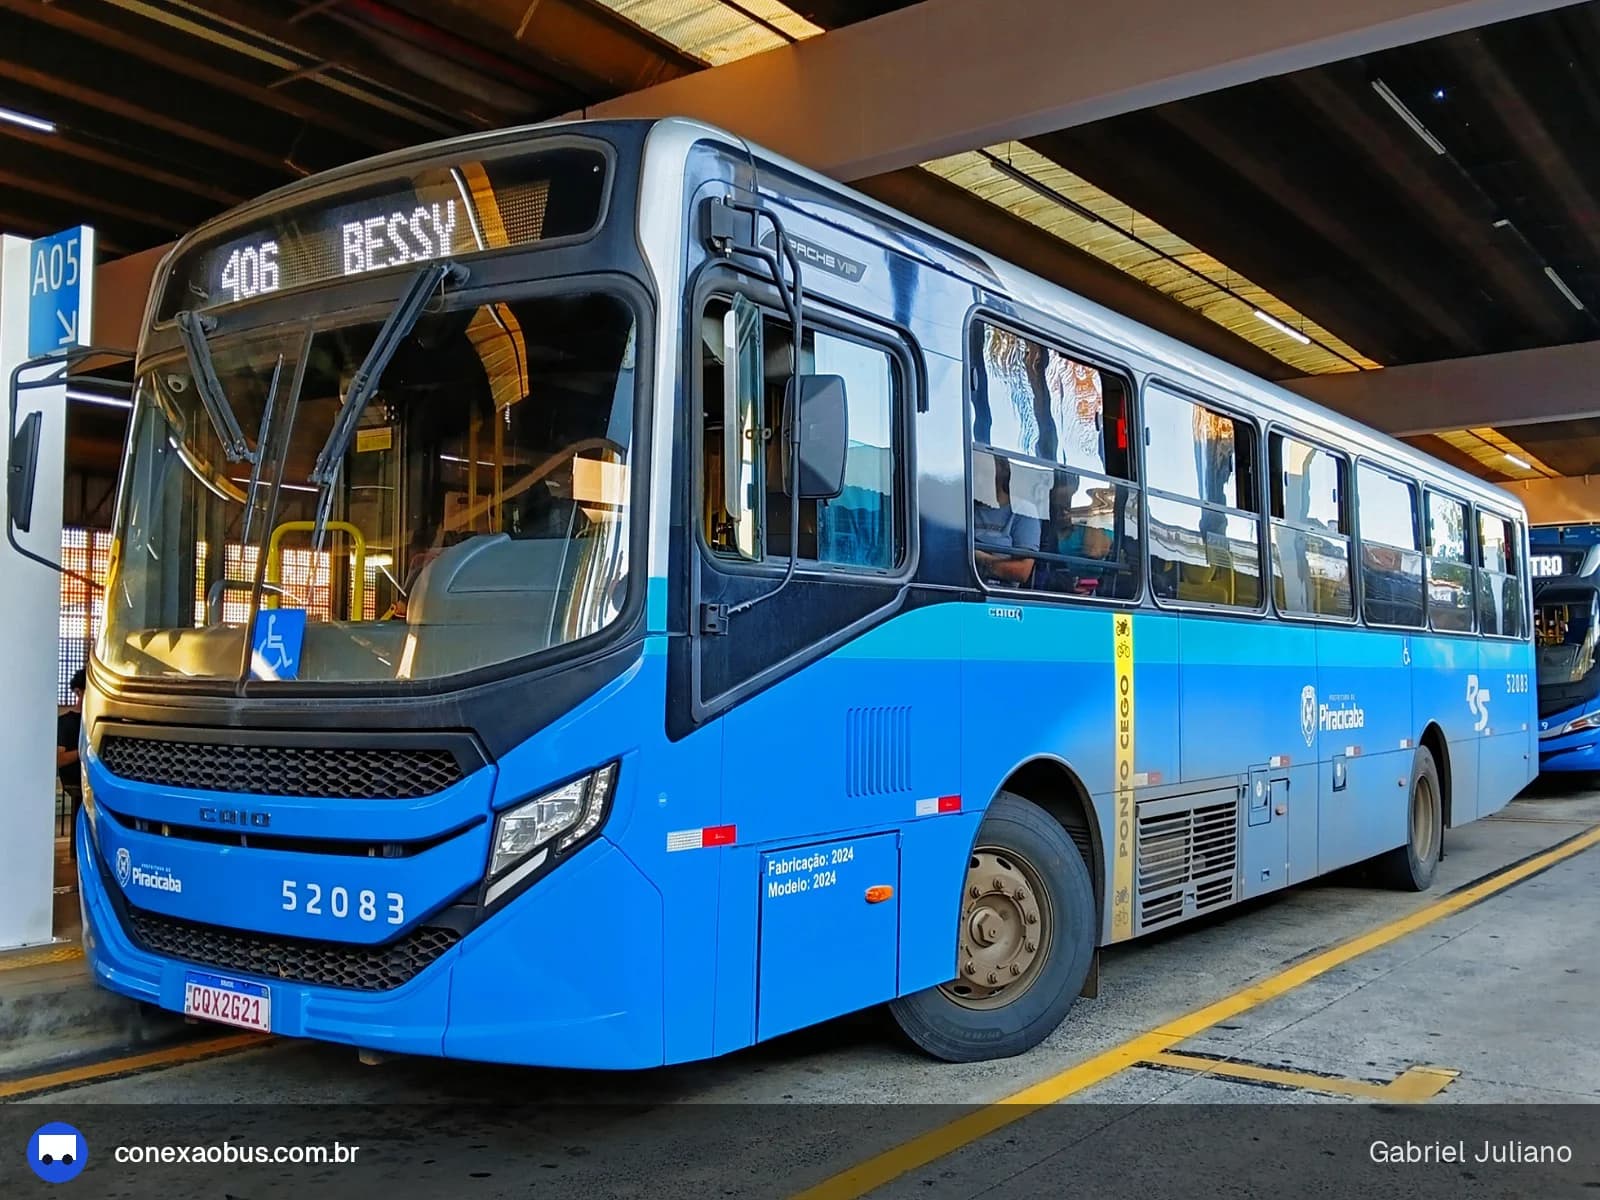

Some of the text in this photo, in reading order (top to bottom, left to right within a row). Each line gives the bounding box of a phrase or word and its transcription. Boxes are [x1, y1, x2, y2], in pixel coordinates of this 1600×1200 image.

[32, 238, 78, 296] A05
[221, 199, 456, 302] 406 BESSY
[785, 238, 858, 275] PACHE VIP
[1529, 555, 1563, 576] TRO
[1319, 702, 1364, 731] Piracicaba
[1119, 675, 1130, 858] PONTO CEGO
[199, 807, 272, 827] CAIO
[768, 846, 854, 876] Fabricação: 2024
[132, 866, 182, 893] Piracicaba
[768, 870, 837, 898] Modelo: 2024
[281, 879, 405, 925] 52083
[192, 987, 260, 1025] CQX2G21
